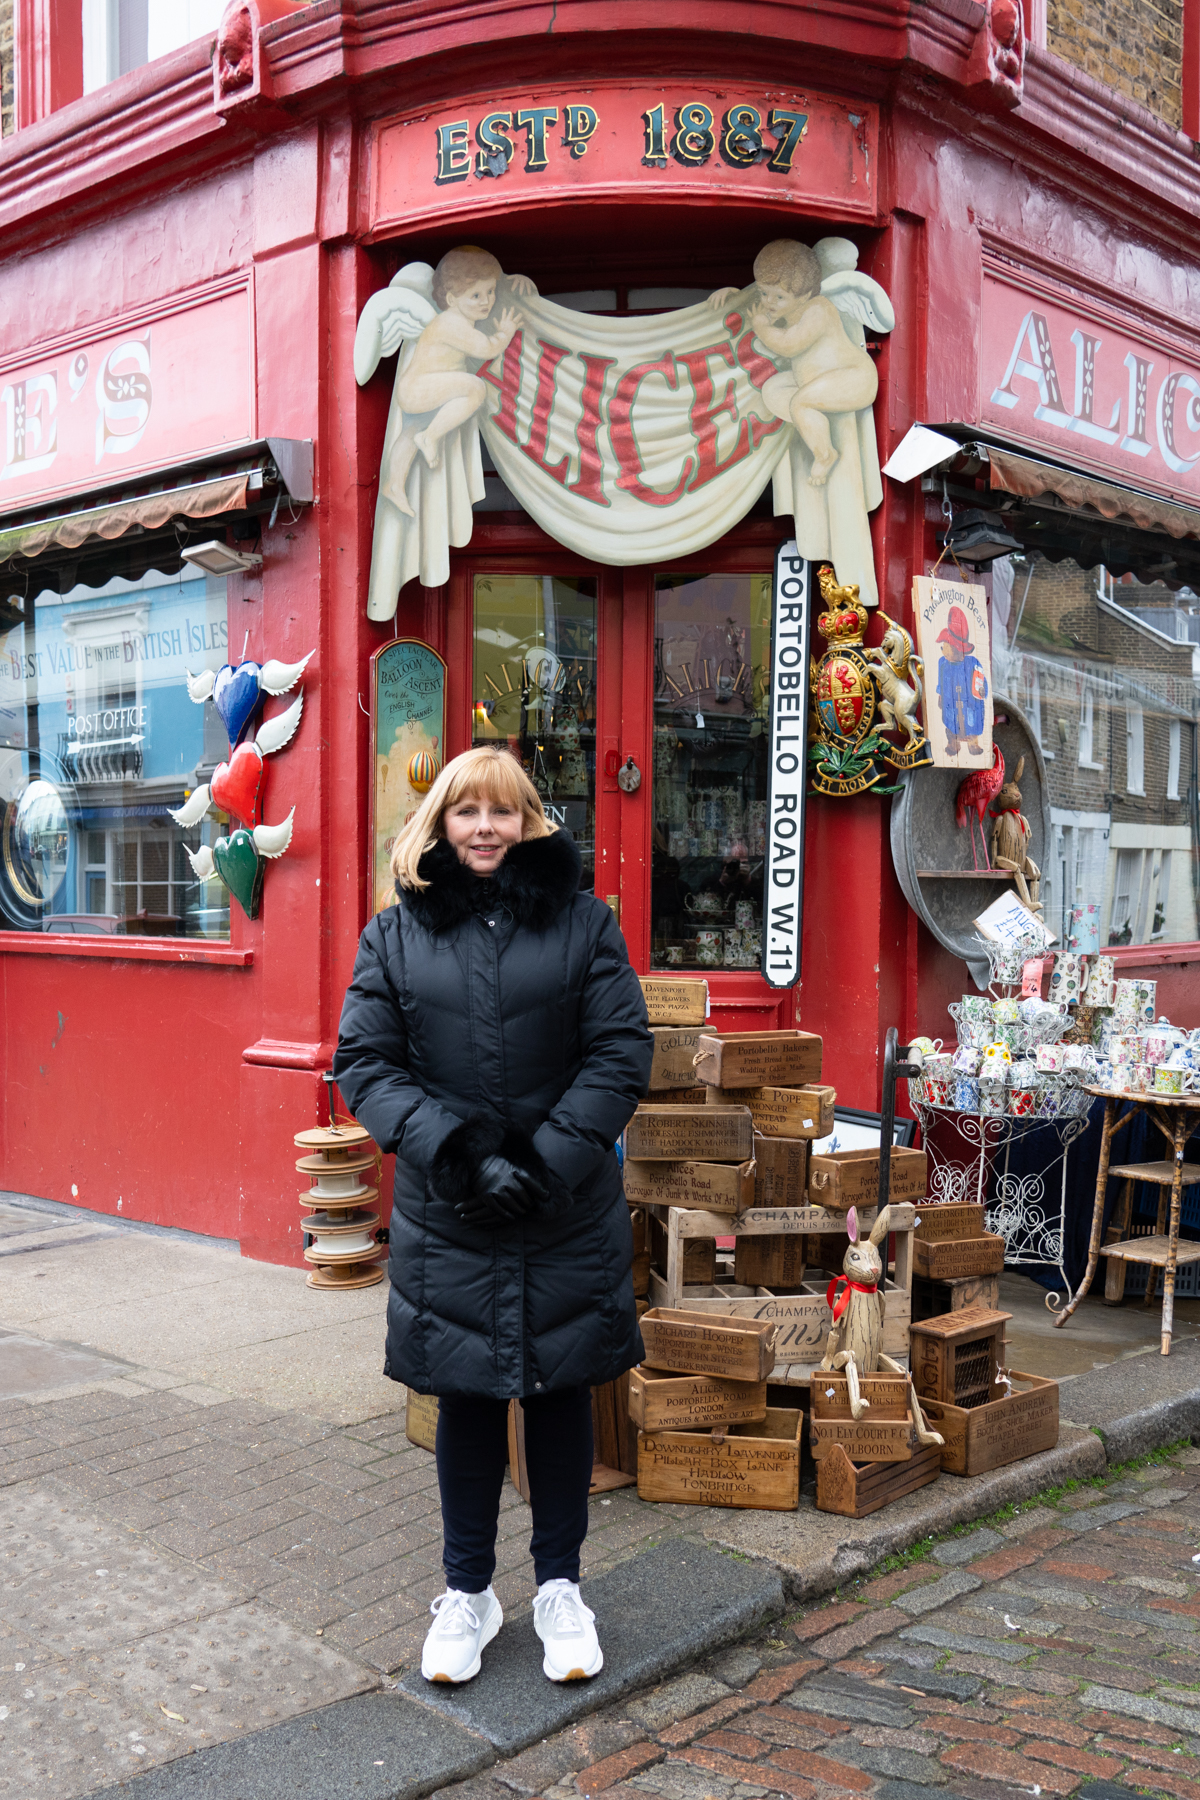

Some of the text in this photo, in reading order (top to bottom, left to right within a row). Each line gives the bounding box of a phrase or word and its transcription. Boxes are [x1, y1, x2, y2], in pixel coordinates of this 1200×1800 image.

[641, 102, 811, 173] 1887
[966, 596, 986, 629] Bear
[46, 642, 93, 674] VALUE
[104, 645, 120, 660] THE
[121, 629, 182, 663] BRITISH
[185, 618, 228, 654] ISLES
[388, 646, 438, 670] SPECTACULAR
[381, 659, 422, 684] BALLOON
[405, 677, 442, 692] ASCENT
[389, 701, 415, 713] ENGLISH
[406, 705, 434, 719] CHANNEL
[68, 705, 148, 736] POST OFFICE
[770, 556, 804, 970] PORTOBELLO ROAD W.11
[839, 776, 867, 793] MON
[645, 984, 687, 993] DAVENPORT
[738, 1043, 809, 1055] Portobello Bakers
[772, 1090, 802, 1104] POPE
[647, 1116, 734, 1128] ROBERT SKINNER
[688, 1130, 740, 1138] FISHMONGERS
[660, 1139, 701, 1147] HADDOCK
[661, 1148, 696, 1156] LONDON
[649, 1173, 711, 1189] Portobello Road
[892, 1170, 908, 1182] Road
[625, 1183, 654, 1198] Purveyor
[656, 1187, 664, 1197] Of
[666, 1187, 681, 1199] Junk
[684, 1190, 689, 1199] &
[692, 1191, 712, 1203] Works
[751, 1209, 872, 1221] CHAMPAGE
[933, 1207, 981, 1219] GEORGE INN
[923, 1228, 954, 1238] LONDON
[937, 1263, 981, 1276] ESTABLISHED
[653, 1323, 744, 1345] RICHARD HOOPER
[655, 1337, 697, 1349] IMPORTER
[716, 1344, 743, 1355] WINES
[667, 1359, 729, 1375] CLERKENWELL
[710, 1354, 743, 1366] STREET
[871, 1382, 905, 1392] TAVERN
[666, 1393, 747, 1407] PORTOBELLO ROAD
[865, 1396, 896, 1405] HOUSE
[689, 1404, 724, 1414] LONDON
[984, 1395, 1046, 1424] JOHN ANDREW
[658, 1416, 691, 1426] ANTIQUES
[702, 1413, 727, 1421] WORKS
[976, 1425, 995, 1439] BOOT
[1005, 1416, 1023, 1428] SHOE
[1027, 1405, 1054, 1421] MAKER
[837, 1426, 853, 1440] ELY
[855, 1427, 888, 1439] COURT
[987, 1420, 1044, 1445] CHAPEL STREET
[835, 1442, 894, 1455] OLBOORN
[1013, 1436, 1029, 1447] IVES
[642, 1439, 796, 1461] DOWNDERRY LAVENDER
[654, 1454, 784, 1472] PILLAR BOX LANE
[689, 1468, 748, 1481] HADLOW
[681, 1478, 756, 1493] TONBRIDGE
[699, 1491, 735, 1504] KENT
